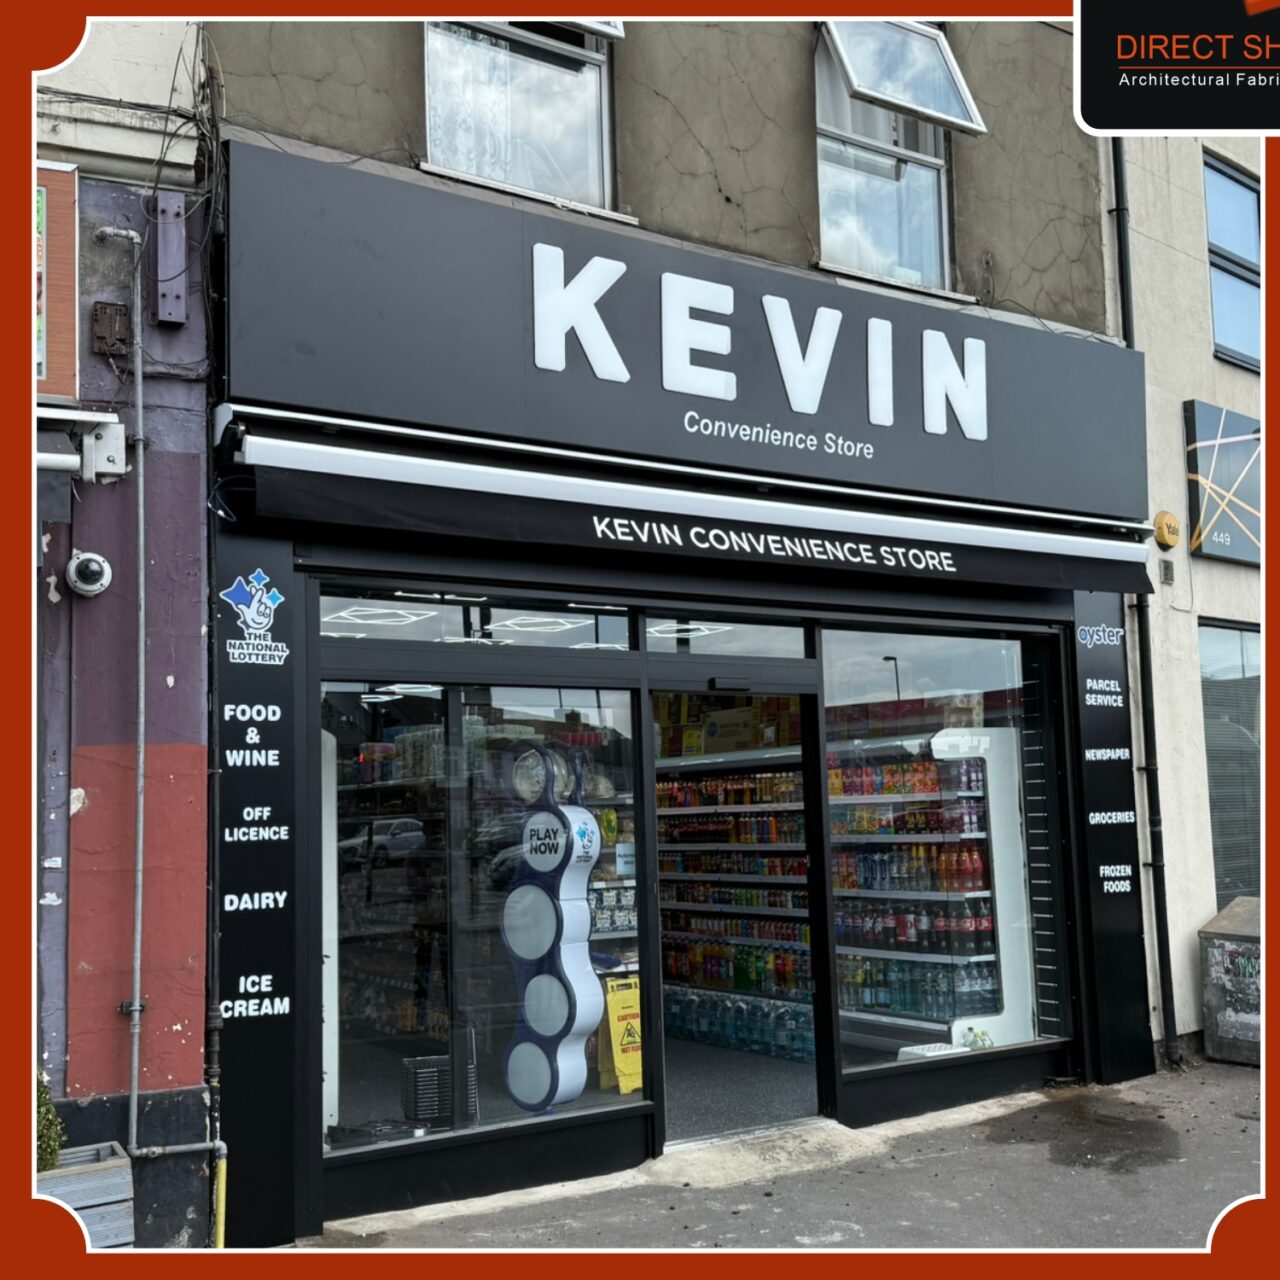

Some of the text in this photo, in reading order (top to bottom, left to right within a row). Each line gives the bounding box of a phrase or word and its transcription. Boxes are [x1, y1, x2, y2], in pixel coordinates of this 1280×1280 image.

[533, 242, 988, 442] KEVIN
[683, 410, 874, 459] Convenience Store
[592, 515, 957, 572] KEVIN CONVENIENCE STORE
[1211, 531, 1231, 545] 449
[247, 632, 271, 642] THE
[1077, 624, 1124, 648] oyster
[228, 641, 287, 653] NATIONAL
[230, 652, 285, 663] LOTTERY
[1086, 678, 1122, 692] PARCEL
[1085, 693, 1124, 707] SERVICE
[223, 704, 282, 722] FOOD
[245, 726, 261, 744] &
[225, 749, 280, 767] WINE
[1085, 748, 1131, 761] NEWSPAPER
[242, 806, 272, 821] OFF
[1088, 811, 1135, 824] GROCERIES
[224, 826, 289, 842] LICENCE
[528, 826, 559, 844] PLAY
[529, 840, 559, 857] NOW
[1099, 865, 1132, 877] FROZEN
[1103, 880, 1131, 893] FOODS
[223, 890, 288, 911] DAIRY
[238, 974, 273, 993] ICE
[219, 997, 290, 1018] CREAM
